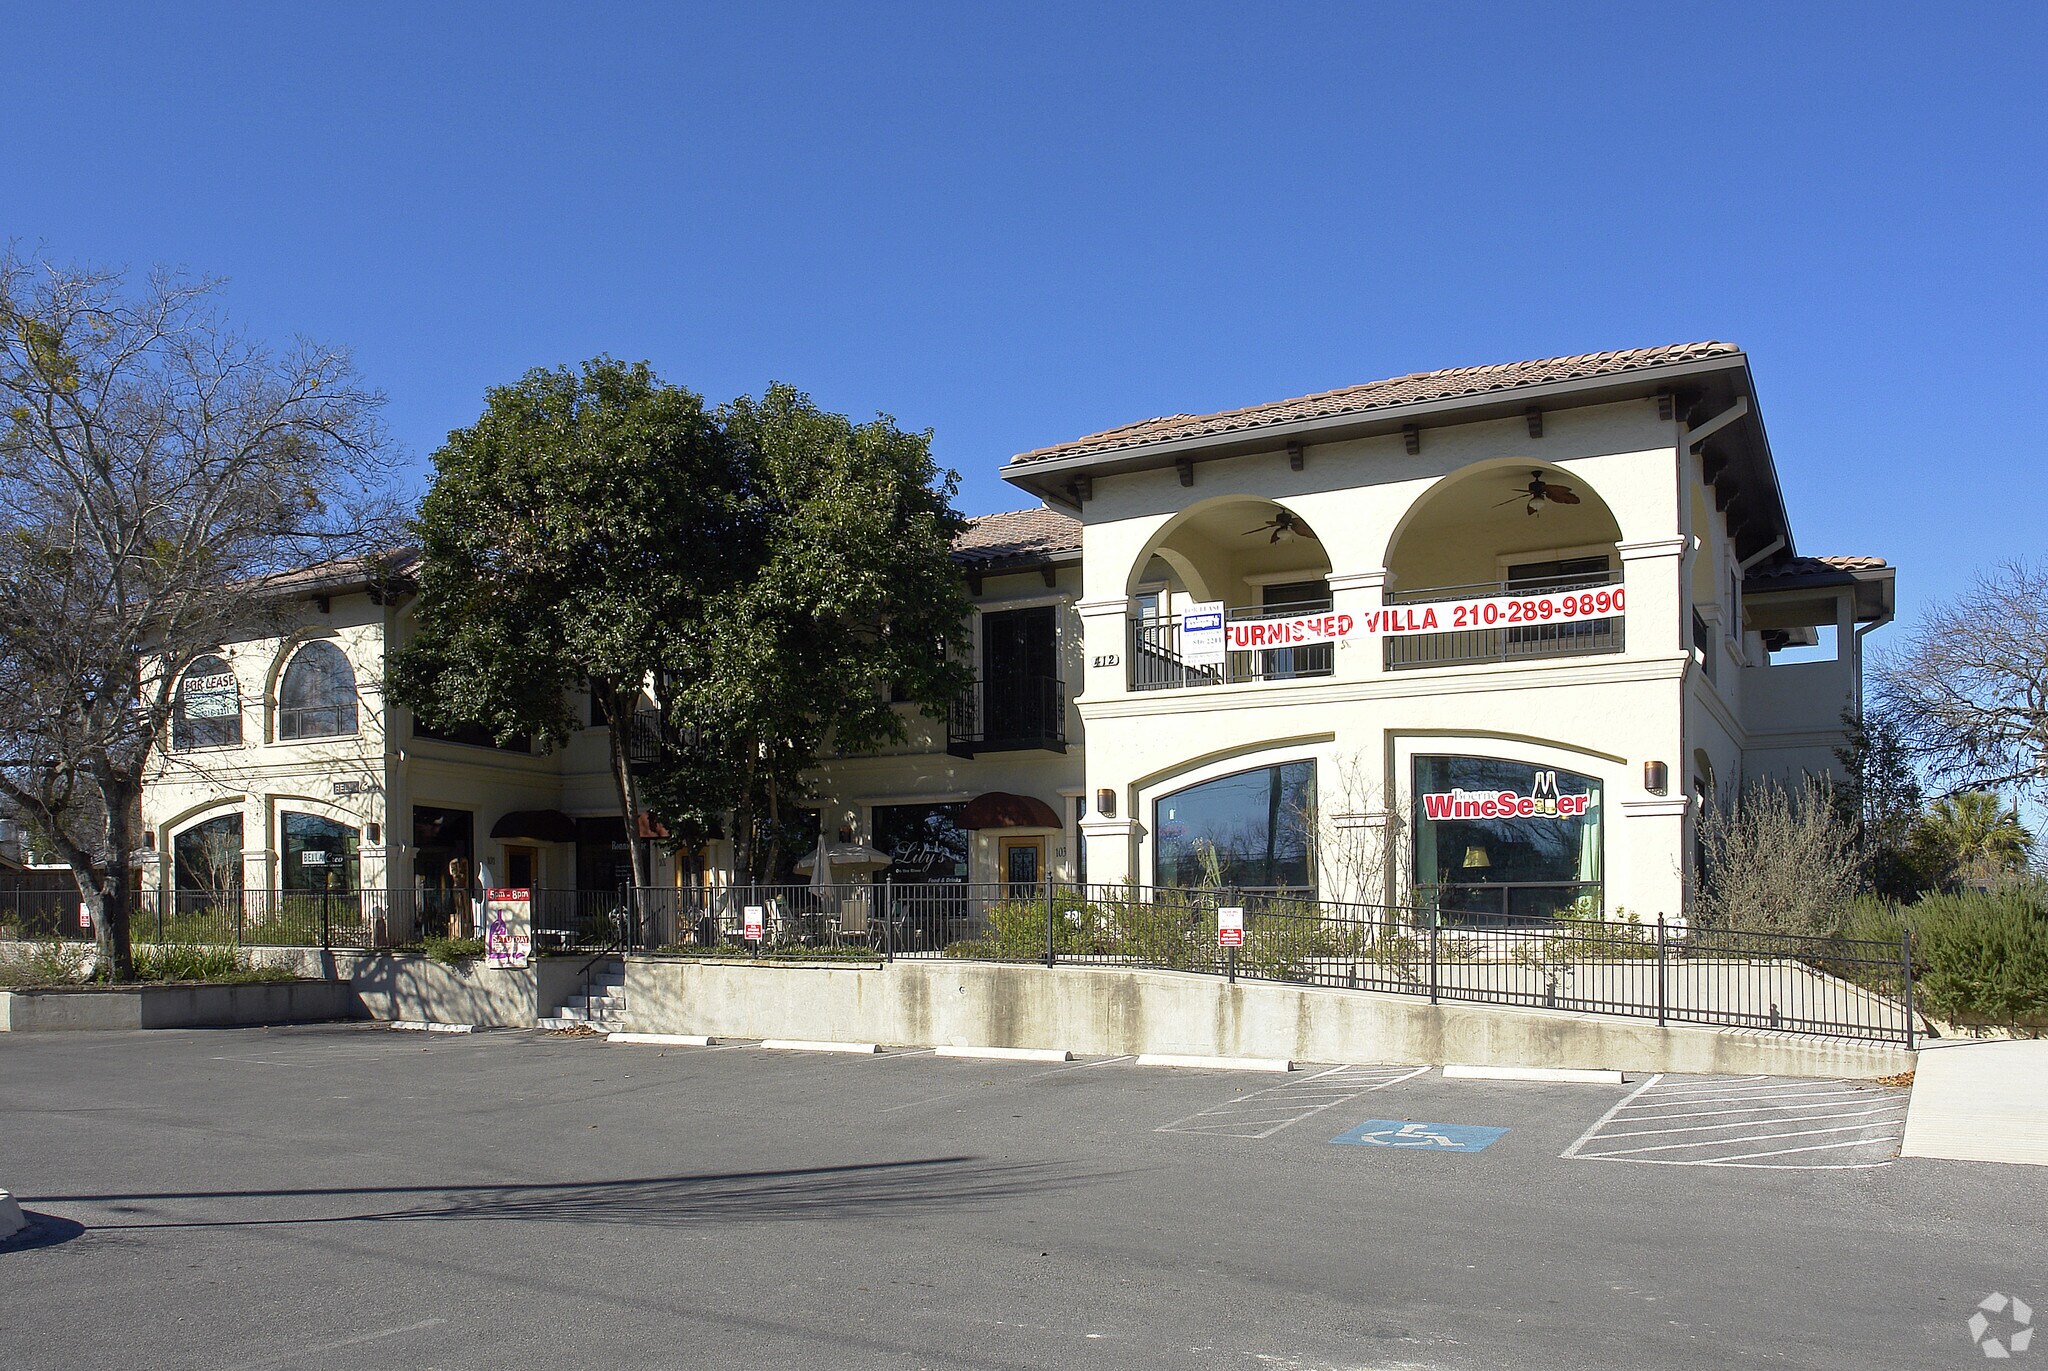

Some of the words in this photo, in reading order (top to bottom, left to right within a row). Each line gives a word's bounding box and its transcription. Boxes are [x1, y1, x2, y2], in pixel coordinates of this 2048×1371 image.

[1226, 614, 1354, 646] FURNISHED
[1364, 607, 1438, 633] VILLA
[1453, 588, 1625, 627] 210-289-9890
[1094, 654, 1115, 667] 412
[205, 675, 235, 690] LEASE
[1454, 789, 1498, 801] Boerne
[303, 852, 325, 863] BELLA
[895, 841, 946, 873] Lily's
[489, 889, 506, 900] 5pm
[511, 889, 529, 900] 8pm
[492, 935, 530, 944] SATUDAY
